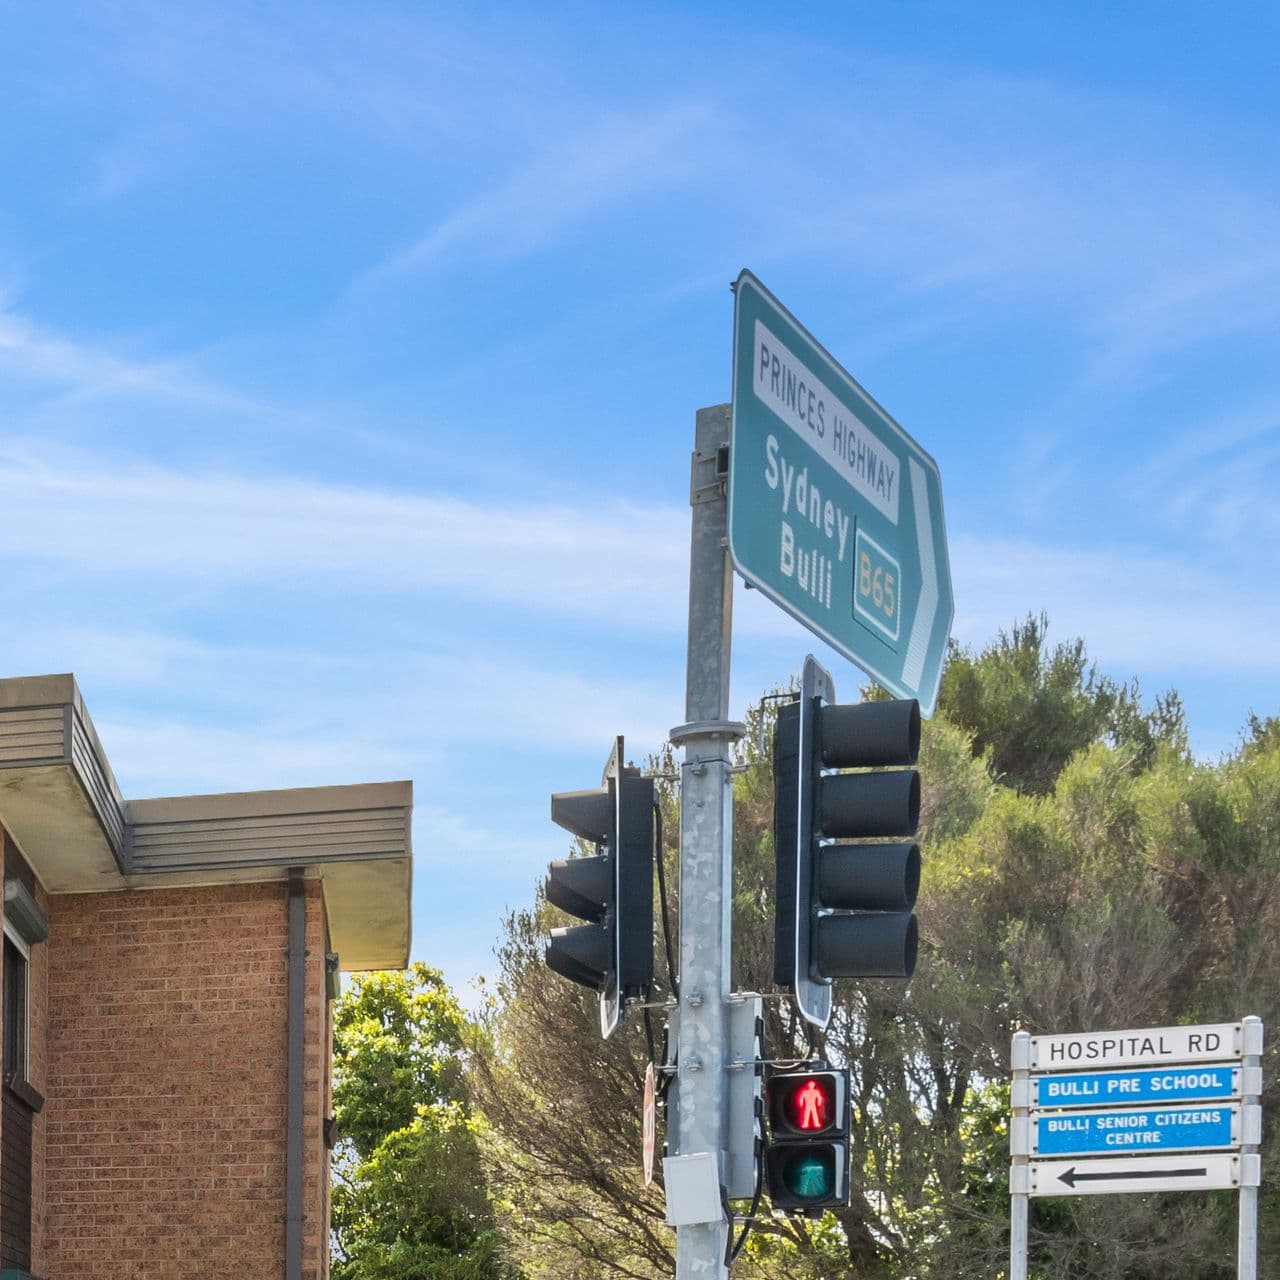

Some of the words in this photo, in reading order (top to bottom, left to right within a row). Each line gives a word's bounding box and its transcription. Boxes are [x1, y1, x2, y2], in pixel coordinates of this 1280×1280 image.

[760, 344, 826, 440] PRINCES
[833, 415, 895, 503] HIGHWAY
[765, 434, 849, 561] Sydney
[780, 522, 832, 609] Bulli
[859, 554, 895, 617] B65
[1051, 1037, 1172, 1060] HOSPITAL
[1188, 1034, 1221, 1053] RD
[1048, 1081, 1099, 1096] BULLI
[1107, 1078, 1141, 1093] PRE
[1150, 1074, 1223, 1091] SCHOOL
[1048, 1119, 1090, 1132] BULLI
[1096, 1116, 1148, 1129] SENIOR
[1155, 1112, 1221, 1126] CITIZENS
[1105, 1131, 1161, 1144] CENTRE
